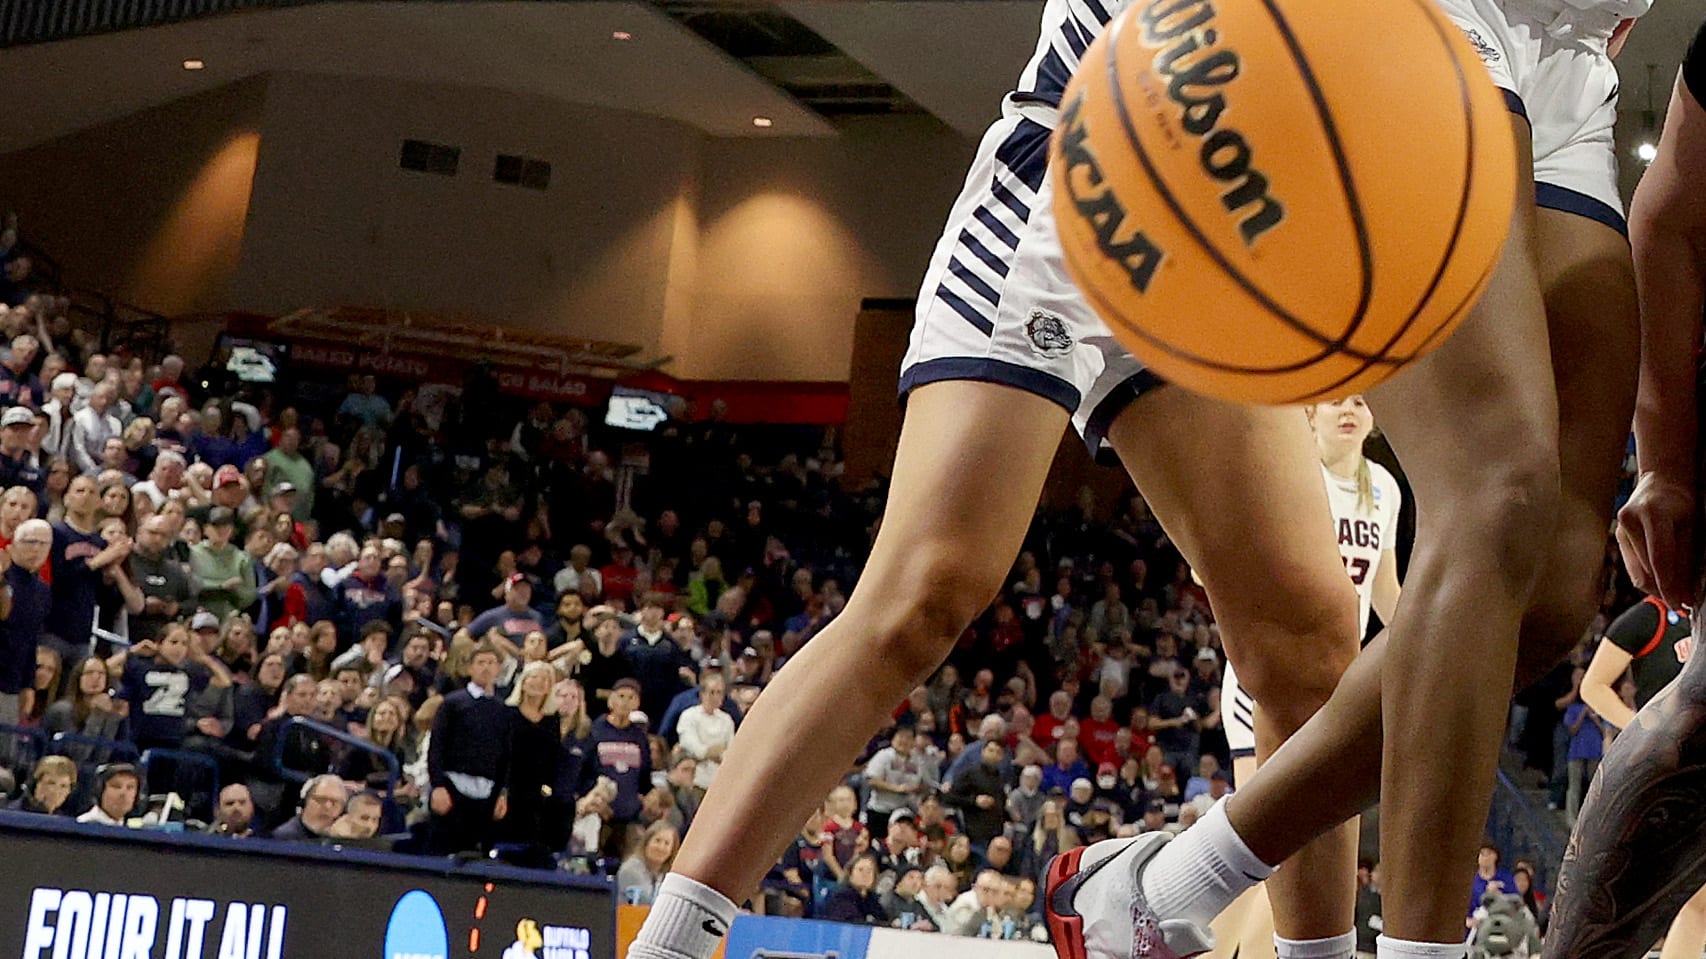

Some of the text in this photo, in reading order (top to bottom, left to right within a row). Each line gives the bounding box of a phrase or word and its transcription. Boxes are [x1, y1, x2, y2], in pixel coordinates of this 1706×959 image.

[1057, 90, 1170, 296] NCAA
[358, 355, 429, 375] POTATO
[528, 378, 587, 397] SALAD
[1337, 518, 1381, 551] AGS
[23, 887, 160, 959] FOUR
[165, 897, 216, 959] IT
